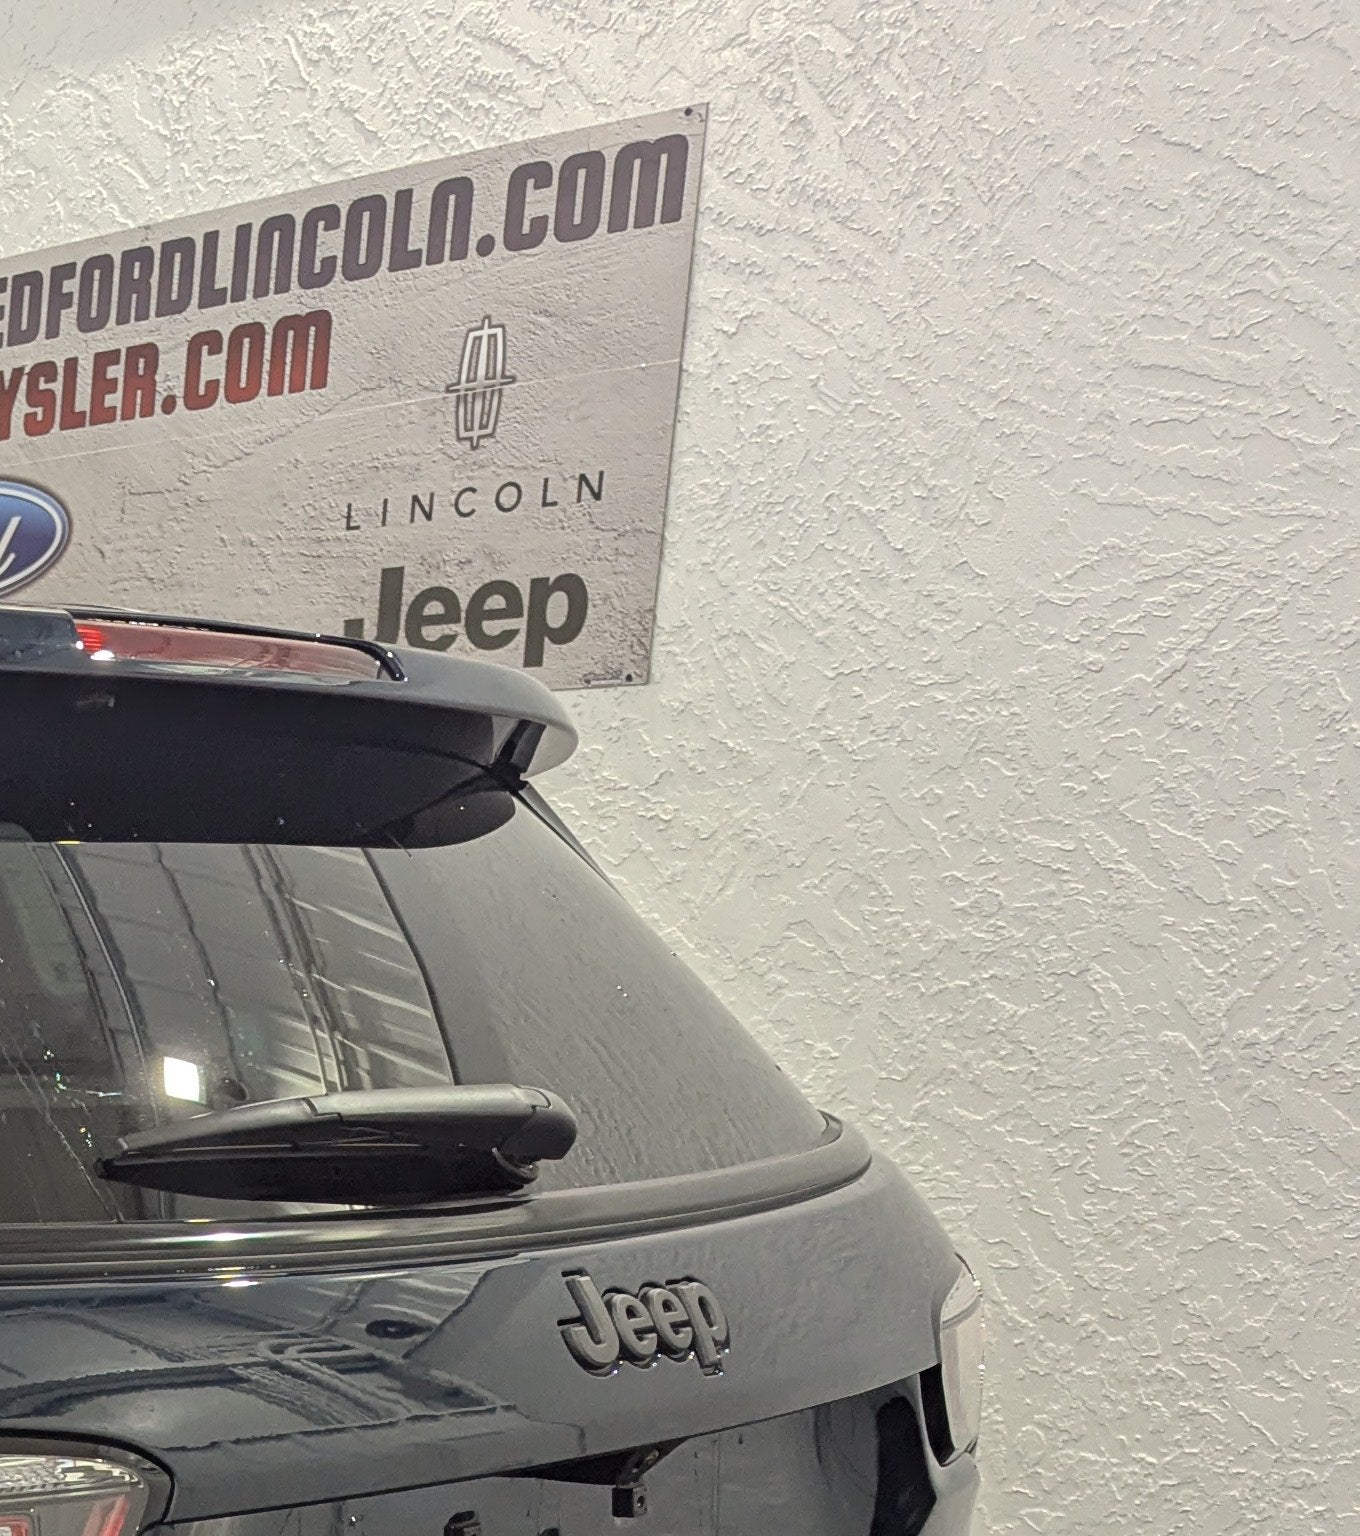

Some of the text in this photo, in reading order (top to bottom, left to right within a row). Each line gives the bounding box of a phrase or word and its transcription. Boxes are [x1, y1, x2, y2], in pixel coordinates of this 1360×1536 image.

[344, 470, 605, 531] LINCOLN
[344, 566, 589, 668] Jeep
[557, 1267, 730, 1377] Jeep
